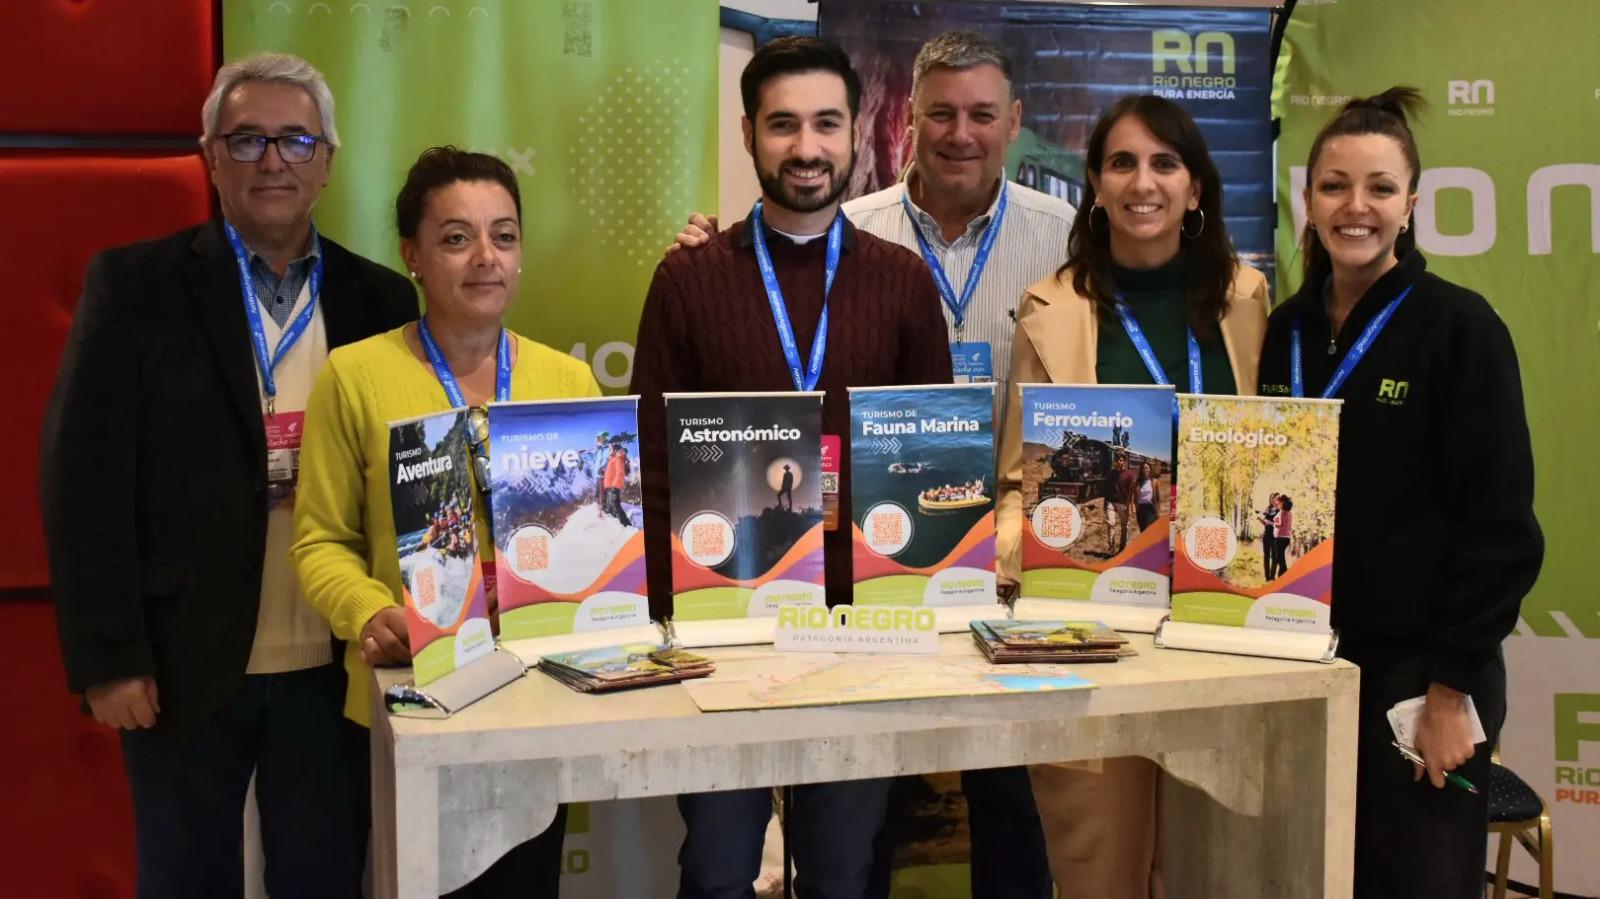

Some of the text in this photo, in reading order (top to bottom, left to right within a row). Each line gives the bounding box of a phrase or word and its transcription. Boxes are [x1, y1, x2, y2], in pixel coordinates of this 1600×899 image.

[1186, 87, 1236, 100] ENERGÍA
[1033, 402, 1077, 411] TURISMO
[863, 409, 919, 420] TURISMO DE
[1033, 410, 1134, 428] Ferroviario
[679, 417, 724, 427] TURISMO
[862, 416, 980, 436] Fauna Marina
[679, 423, 801, 443] Astronómico
[395, 447, 422, 461] TURISMO
[502, 444, 580, 472] nieve
[396, 454, 453, 485] Aventura
[792, 634, 920, 645] PATAGONIA ARGENTINA
